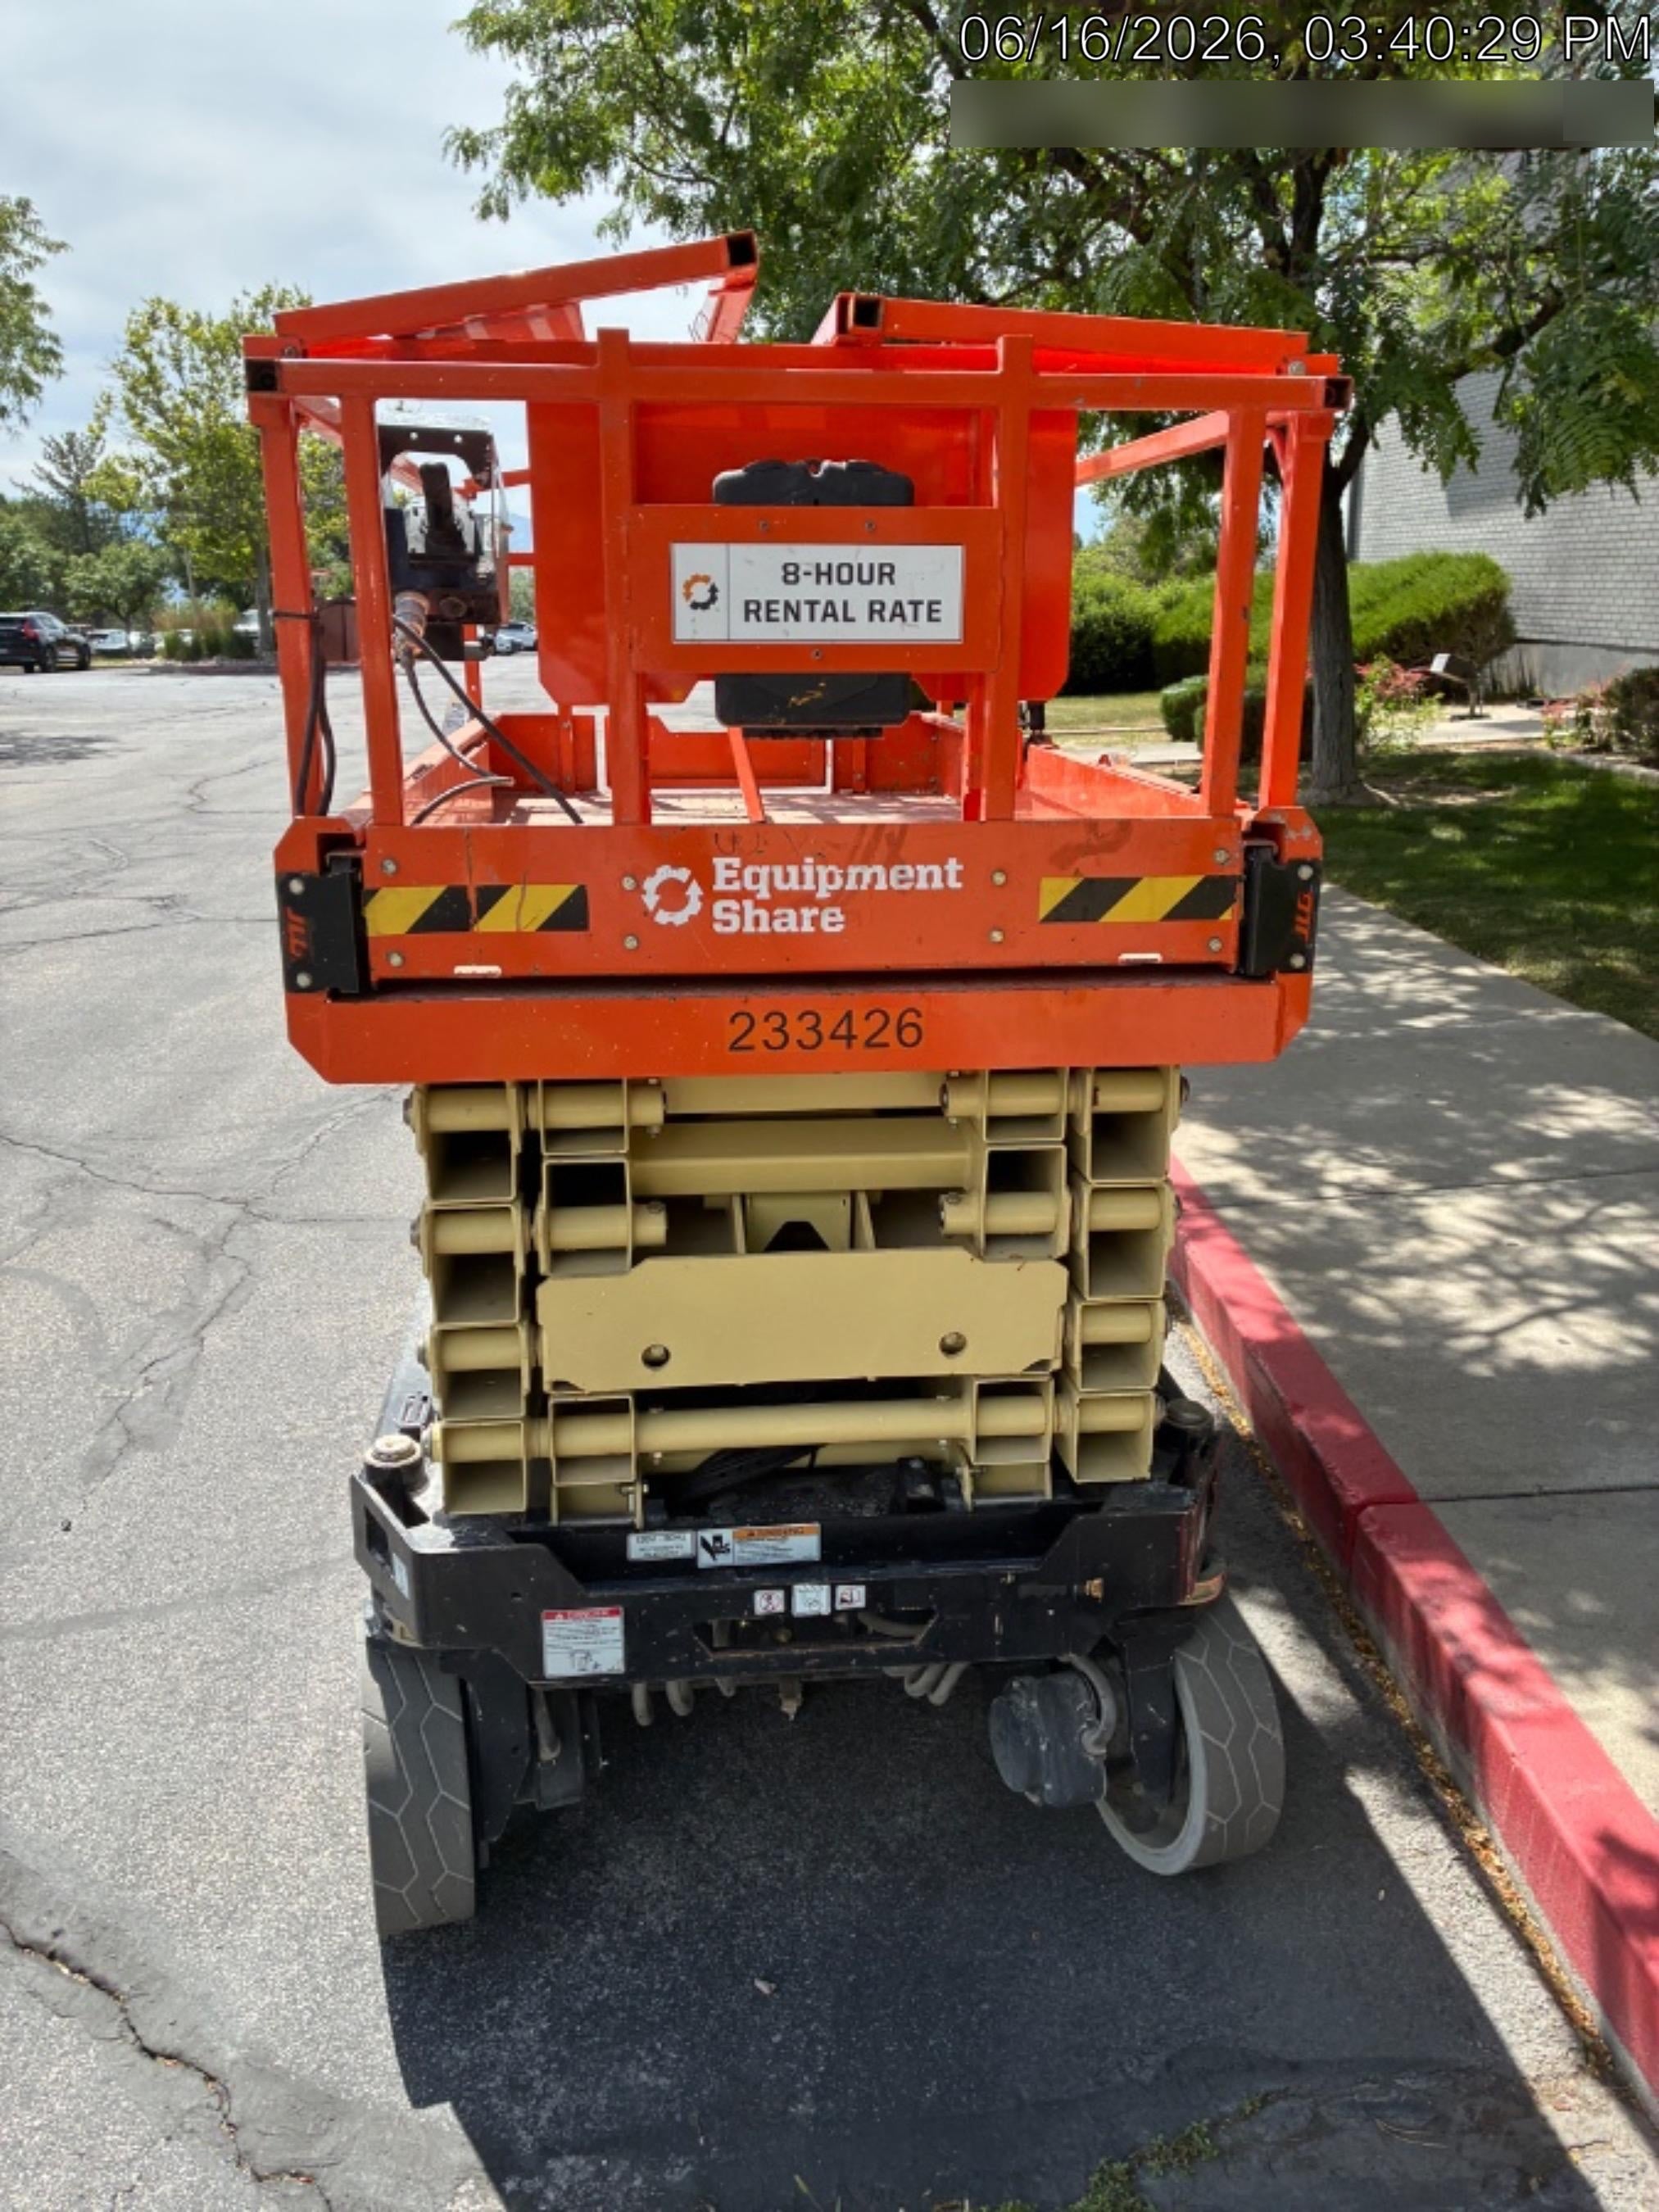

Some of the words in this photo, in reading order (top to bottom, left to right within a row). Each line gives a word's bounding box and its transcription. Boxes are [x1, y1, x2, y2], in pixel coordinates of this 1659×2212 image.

[781, 562, 896, 587] 8-HOUR
[743, 599, 857, 623] RENTAL
[867, 599, 943, 623] RATE
[713, 857, 963, 899] Equipment
[712, 899, 846, 934] Share
[728, 1007, 925, 1052] 233426
